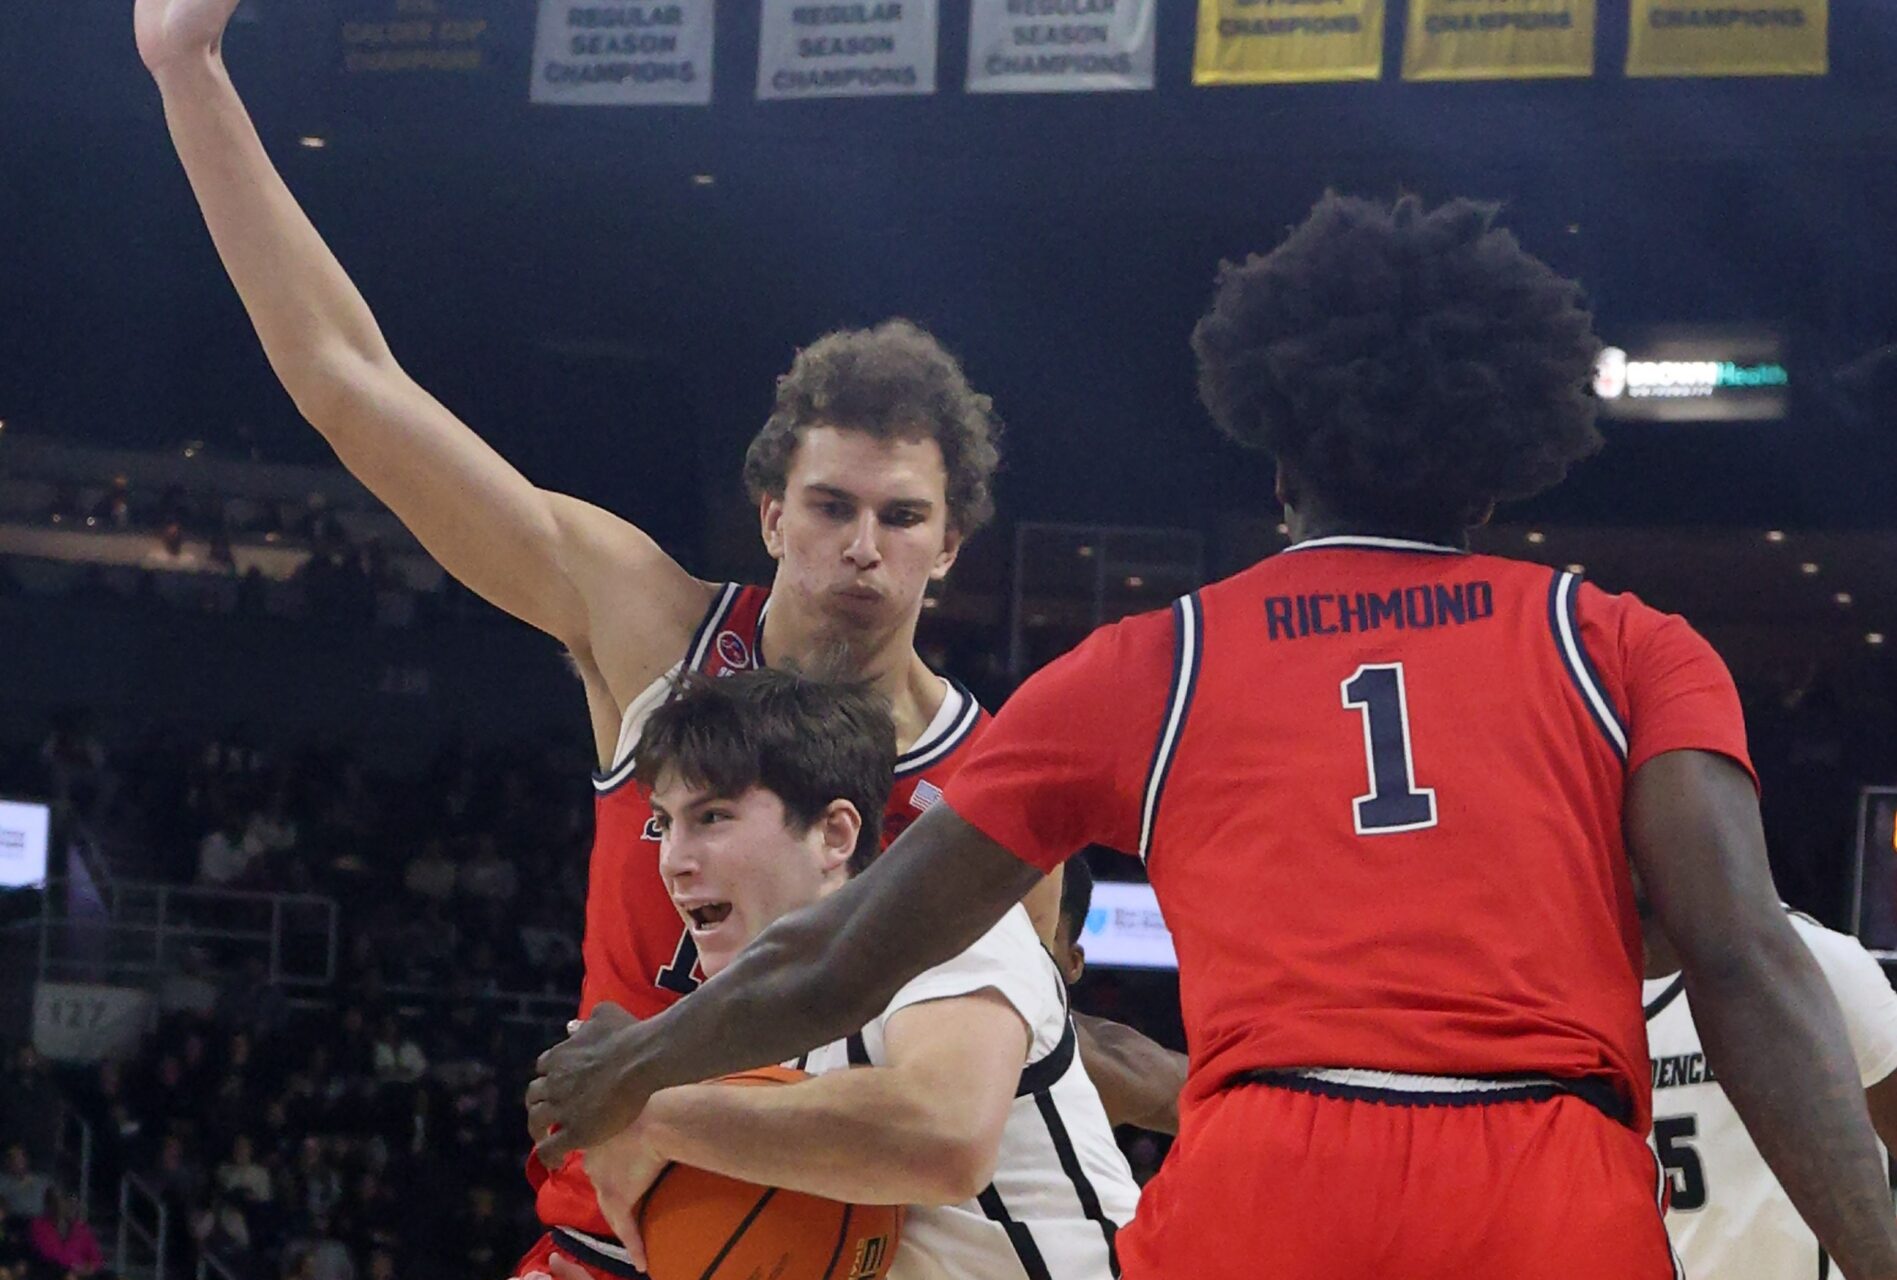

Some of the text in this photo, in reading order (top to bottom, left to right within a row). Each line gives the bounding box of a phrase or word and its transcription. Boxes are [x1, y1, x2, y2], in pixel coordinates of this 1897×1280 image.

[568, 6, 682, 27] REGULAR
[793, 4, 902, 25] REGULAR
[1426, 12, 1573, 34] CHAMPIONS
[1650, 8, 1806, 28] CHAMPIONS
[1012, 25, 1108, 46] SEASON
[1219, 16, 1361, 37] CHAMPIONS
[571, 34, 677, 55] SEASON
[798, 36, 894, 58] SEASON
[544, 60, 697, 84] CHAMPIONS
[985, 52, 1133, 76] CHAMPIONS
[772, 64, 917, 91] CHAMPIONS
[1264, 580, 1494, 641] RICHMOND
[1340, 662, 1438, 836] 1
